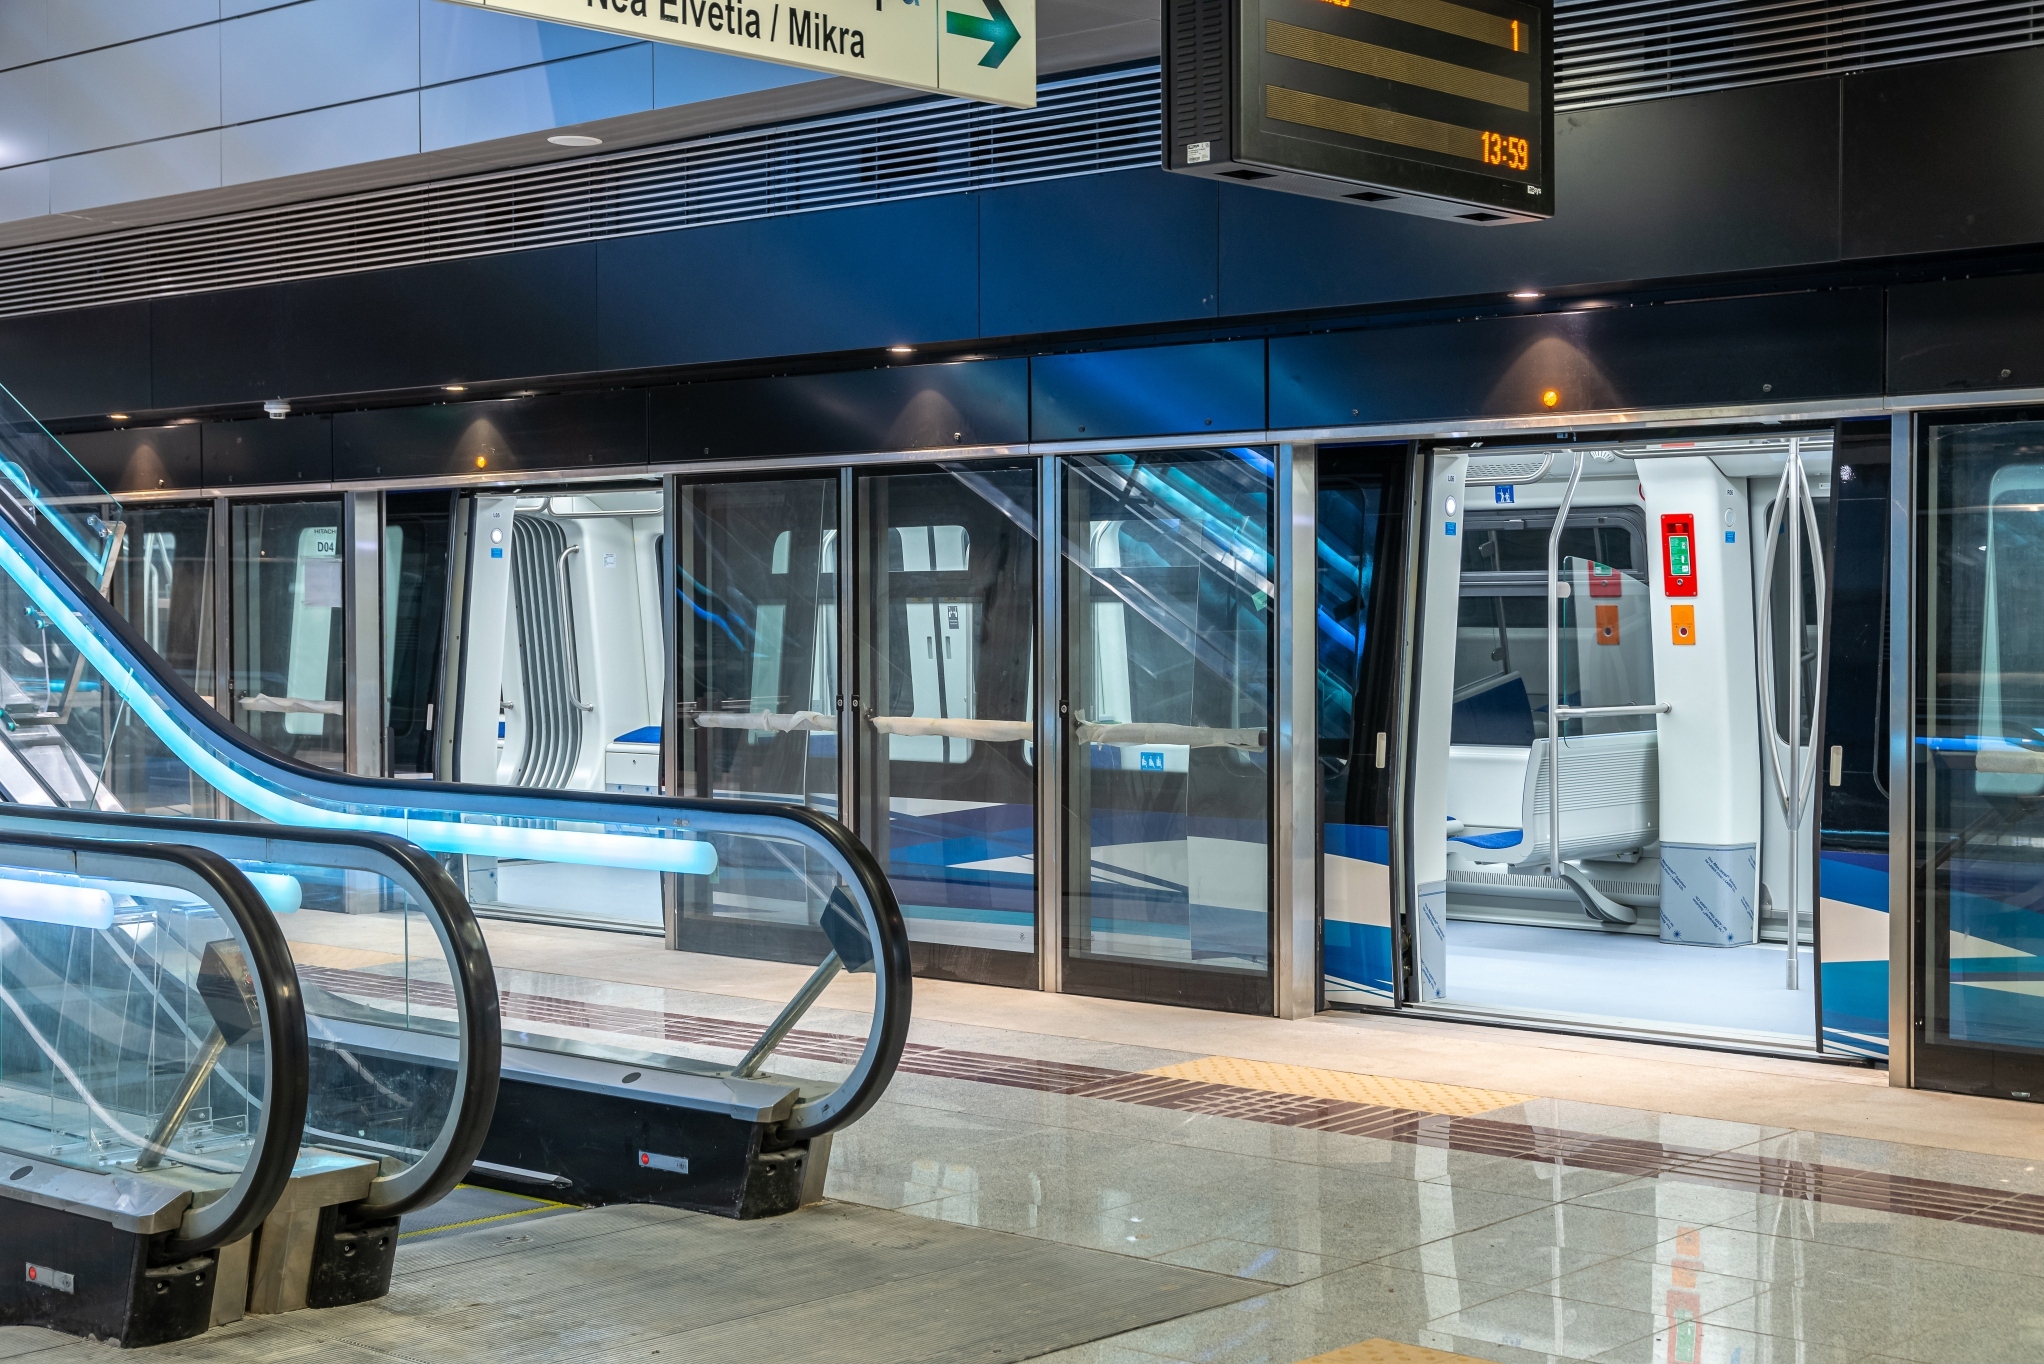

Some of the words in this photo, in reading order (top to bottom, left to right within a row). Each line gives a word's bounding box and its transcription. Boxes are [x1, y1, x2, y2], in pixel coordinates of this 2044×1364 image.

[660, 0, 761, 39] Elvetia
[789, 7, 865, 59] Mikra
[1511, 20, 1519, 52] 1
[1481, 131, 1528, 171] 13:59
[317, 541, 335, 553] D04
